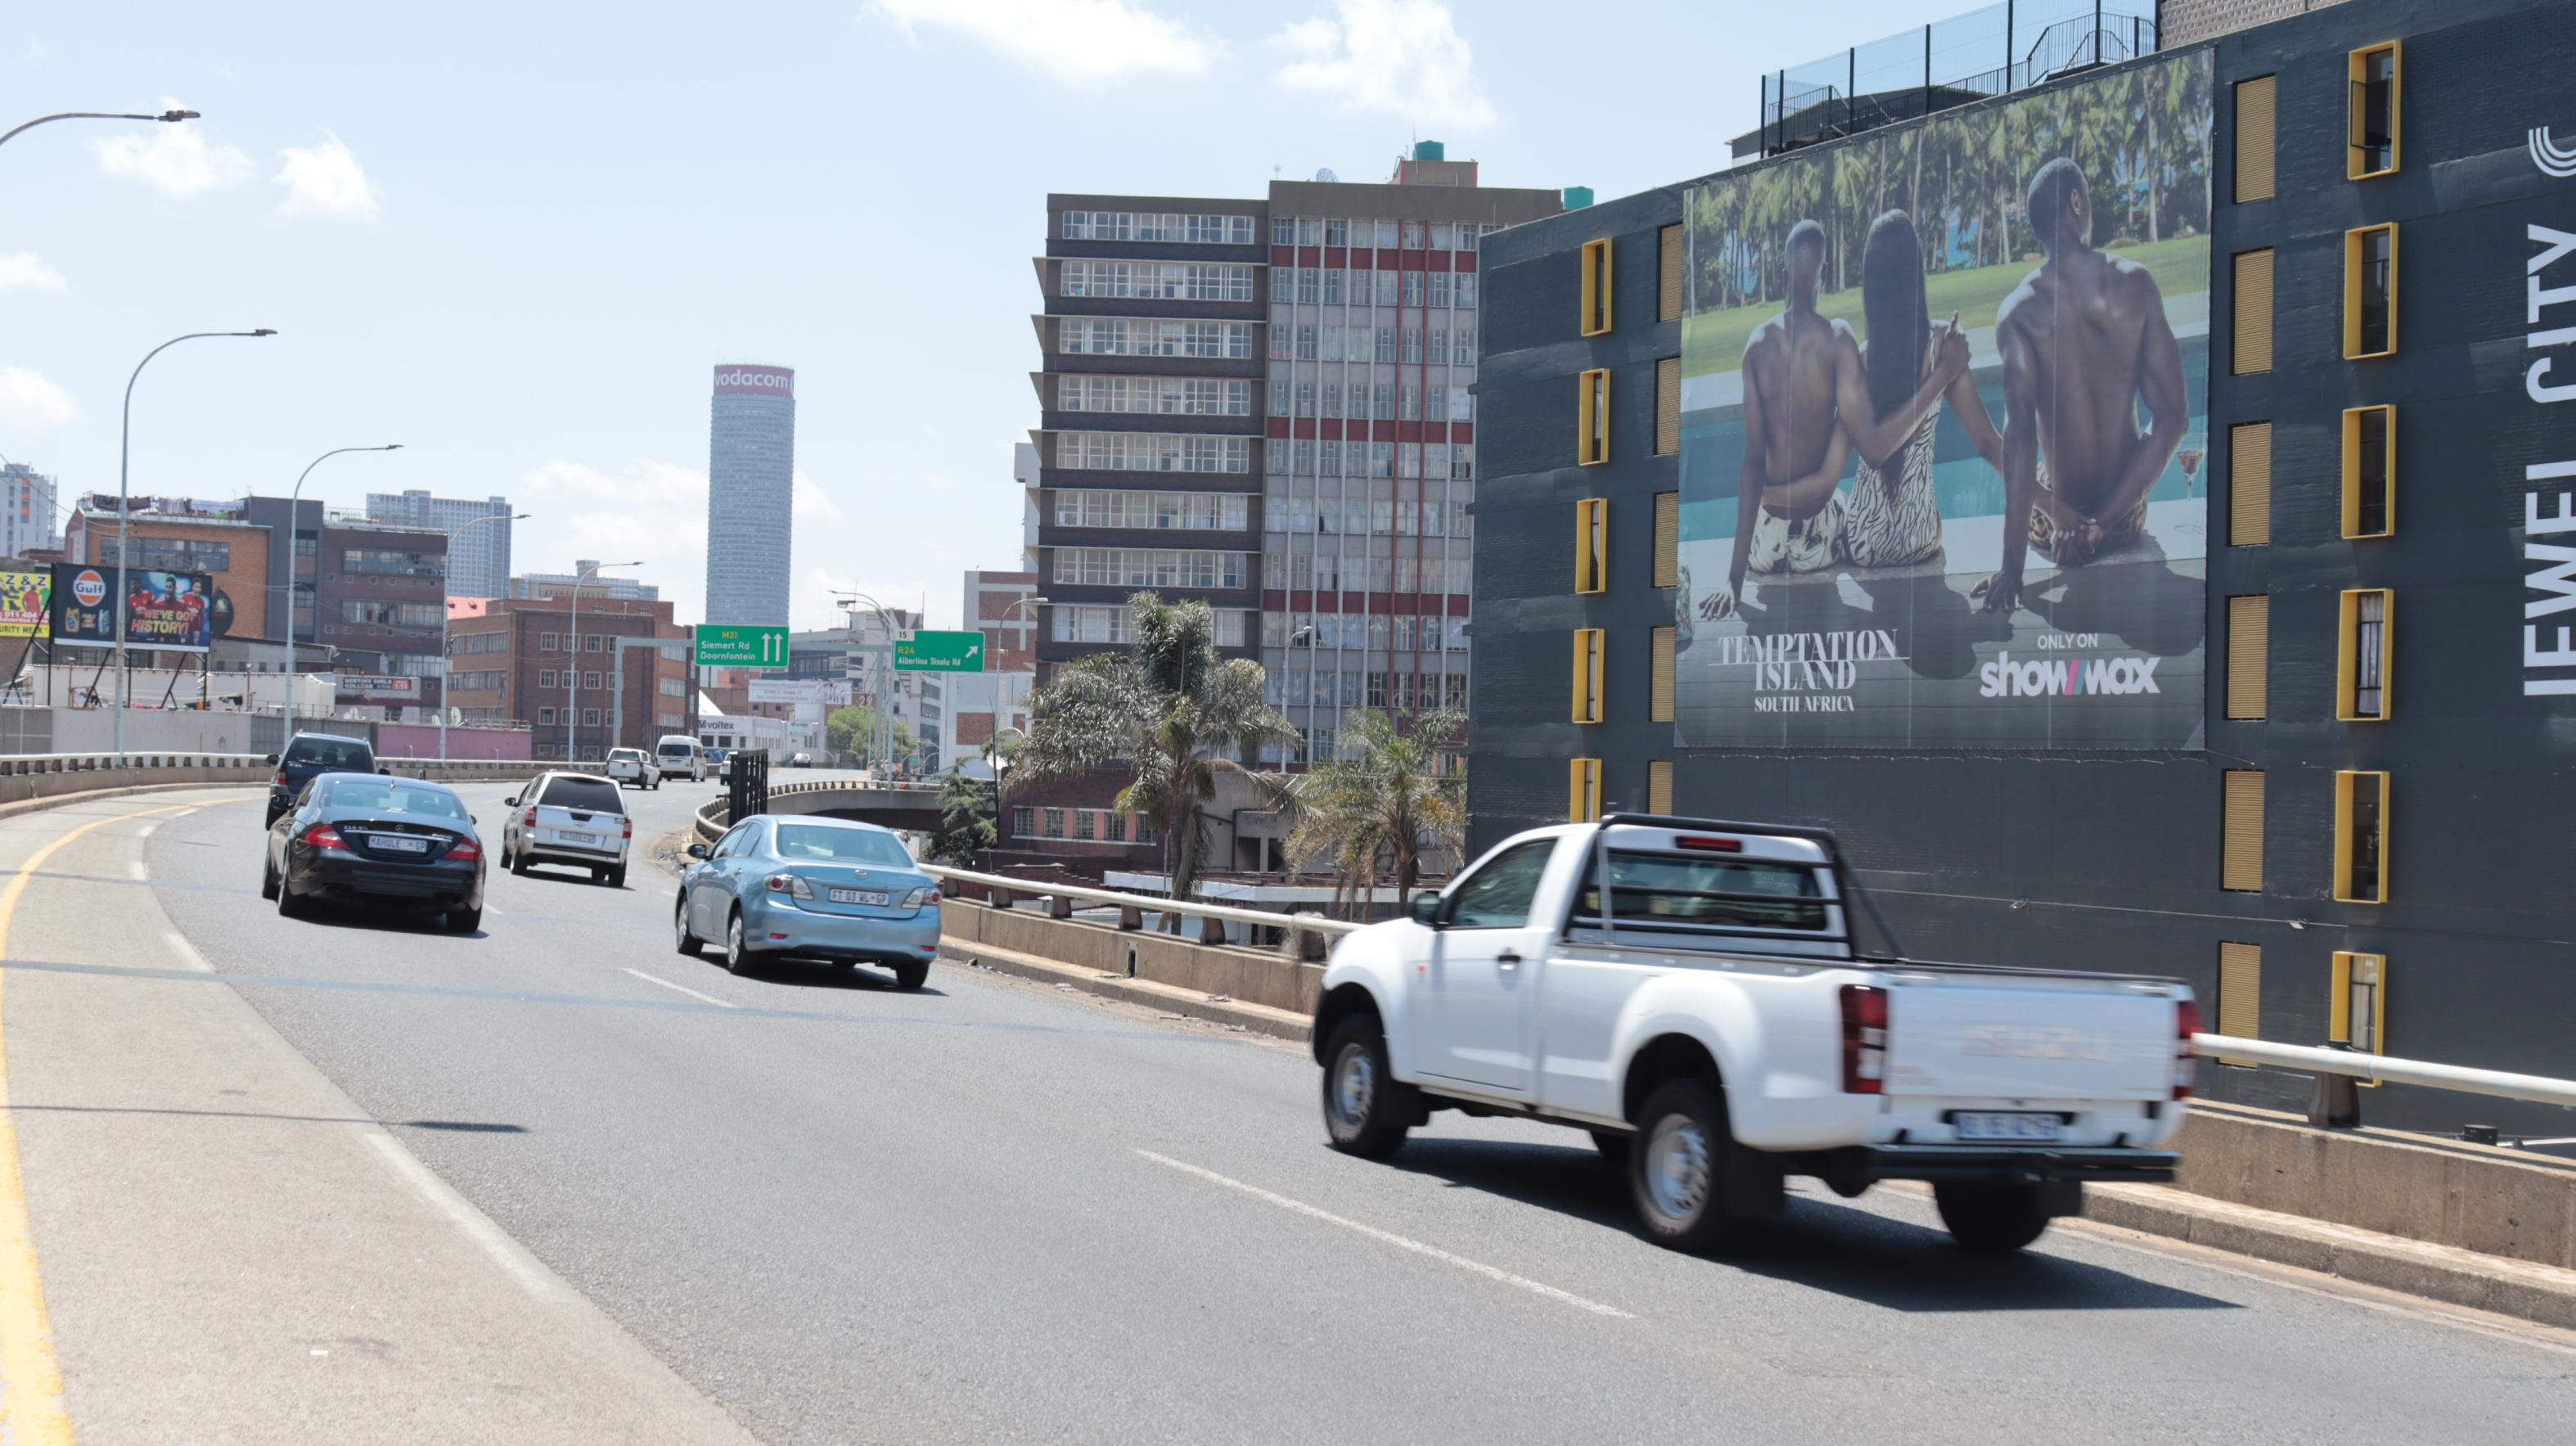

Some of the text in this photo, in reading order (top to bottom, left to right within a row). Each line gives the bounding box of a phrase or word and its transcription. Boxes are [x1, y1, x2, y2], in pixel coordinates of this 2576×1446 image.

[2526, 223, 2576, 403] CITY
[714, 368, 788, 390] vodacom
[6, 574, 47, 587] Z & Z
[76, 582, 103, 594] Gulf
[143, 608, 197, 622] WE'VE GOT
[22, 625, 43, 634] WER
[131, 619, 189, 635] HISTORY!
[722, 630, 737, 639] M31
[701, 641, 750, 650] Siemert Rd
[1718, 628, 1898, 664] TEMPTATION
[2037, 633, 2098, 650] ONLY ON
[700, 651, 756, 660] Doornfontein
[898, 645, 915, 654] R24
[898, 656, 927, 665] Albertina
[952, 658, 961, 666] Rd
[1754, 660, 1857, 691] ISLAND
[1754, 696, 1854, 713] SOUTH AFRICA
[708, 721, 734, 730] voltex
